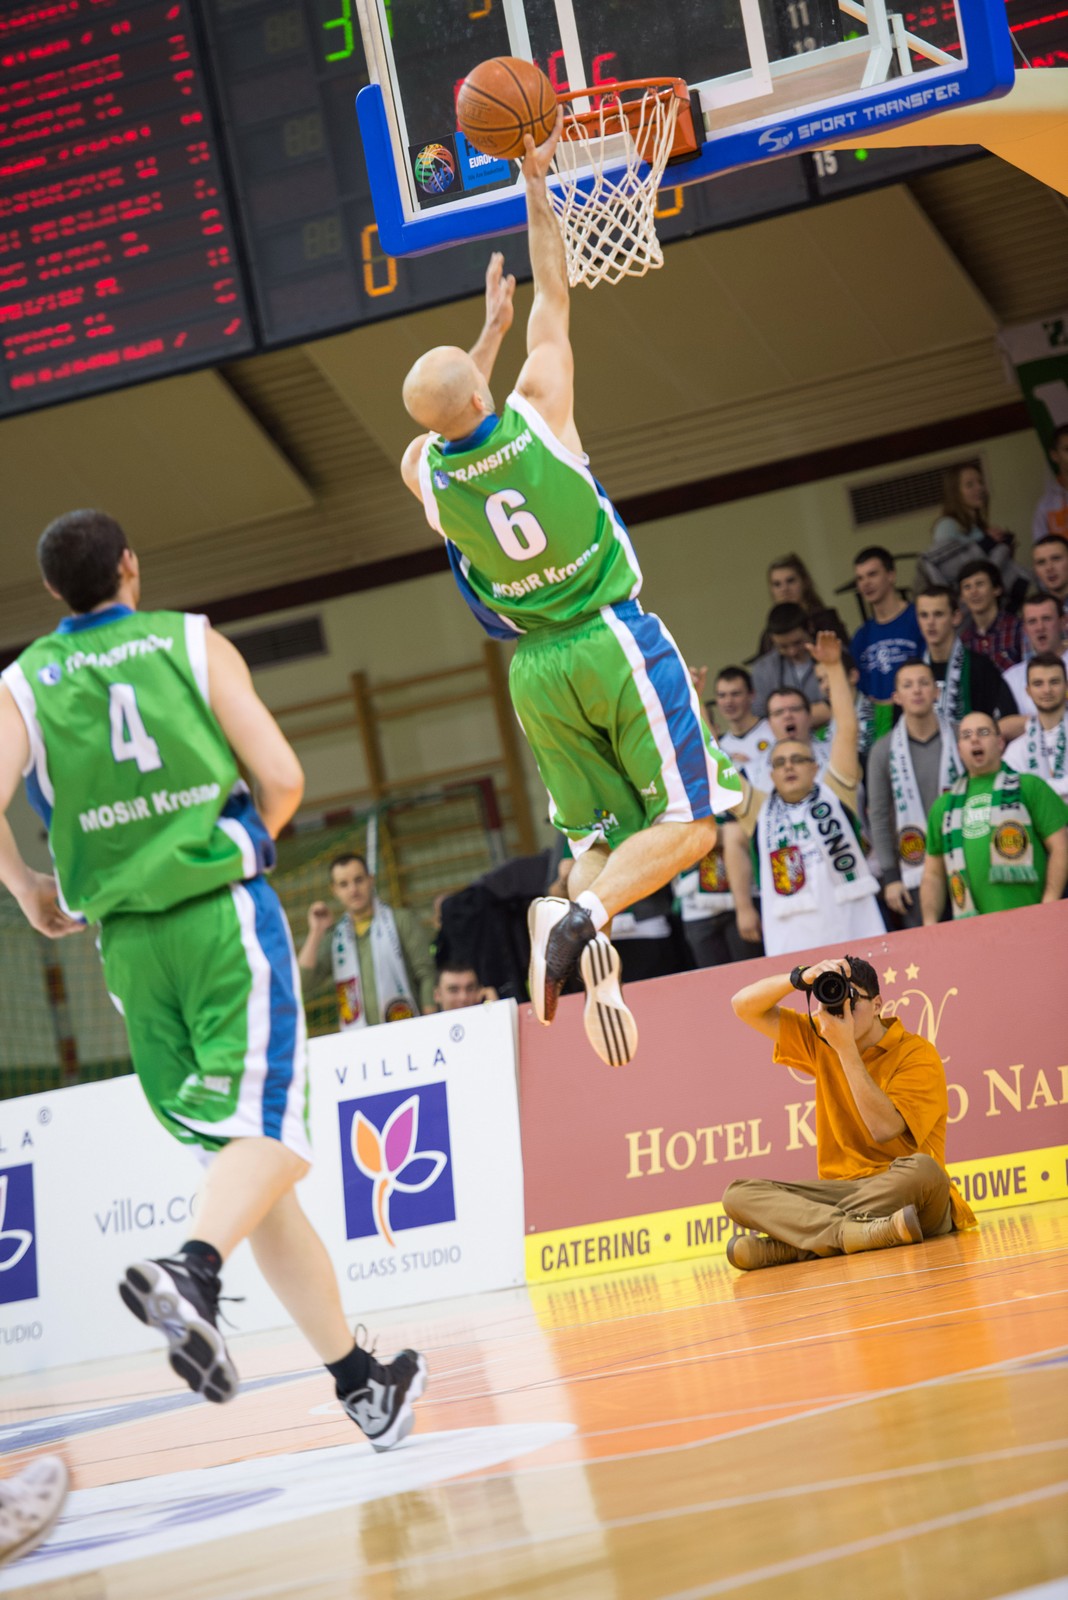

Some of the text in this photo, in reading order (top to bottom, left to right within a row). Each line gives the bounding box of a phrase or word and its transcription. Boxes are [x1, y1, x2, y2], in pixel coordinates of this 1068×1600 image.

[797, 82, 960, 140] SPORT TRANSFER
[812, 150, 838, 177] 15
[484, 487, 547, 561] 6
[108, 682, 164, 773] 4
[78, 782, 221, 833] MOSiR Krosno
[335, 1048, 446, 1085] VILLA
[624, 1117, 773, 1179] HOTEL
[346, 1244, 462, 1282] GLASS STUDIO
[541, 1227, 651, 1273] CATERING
